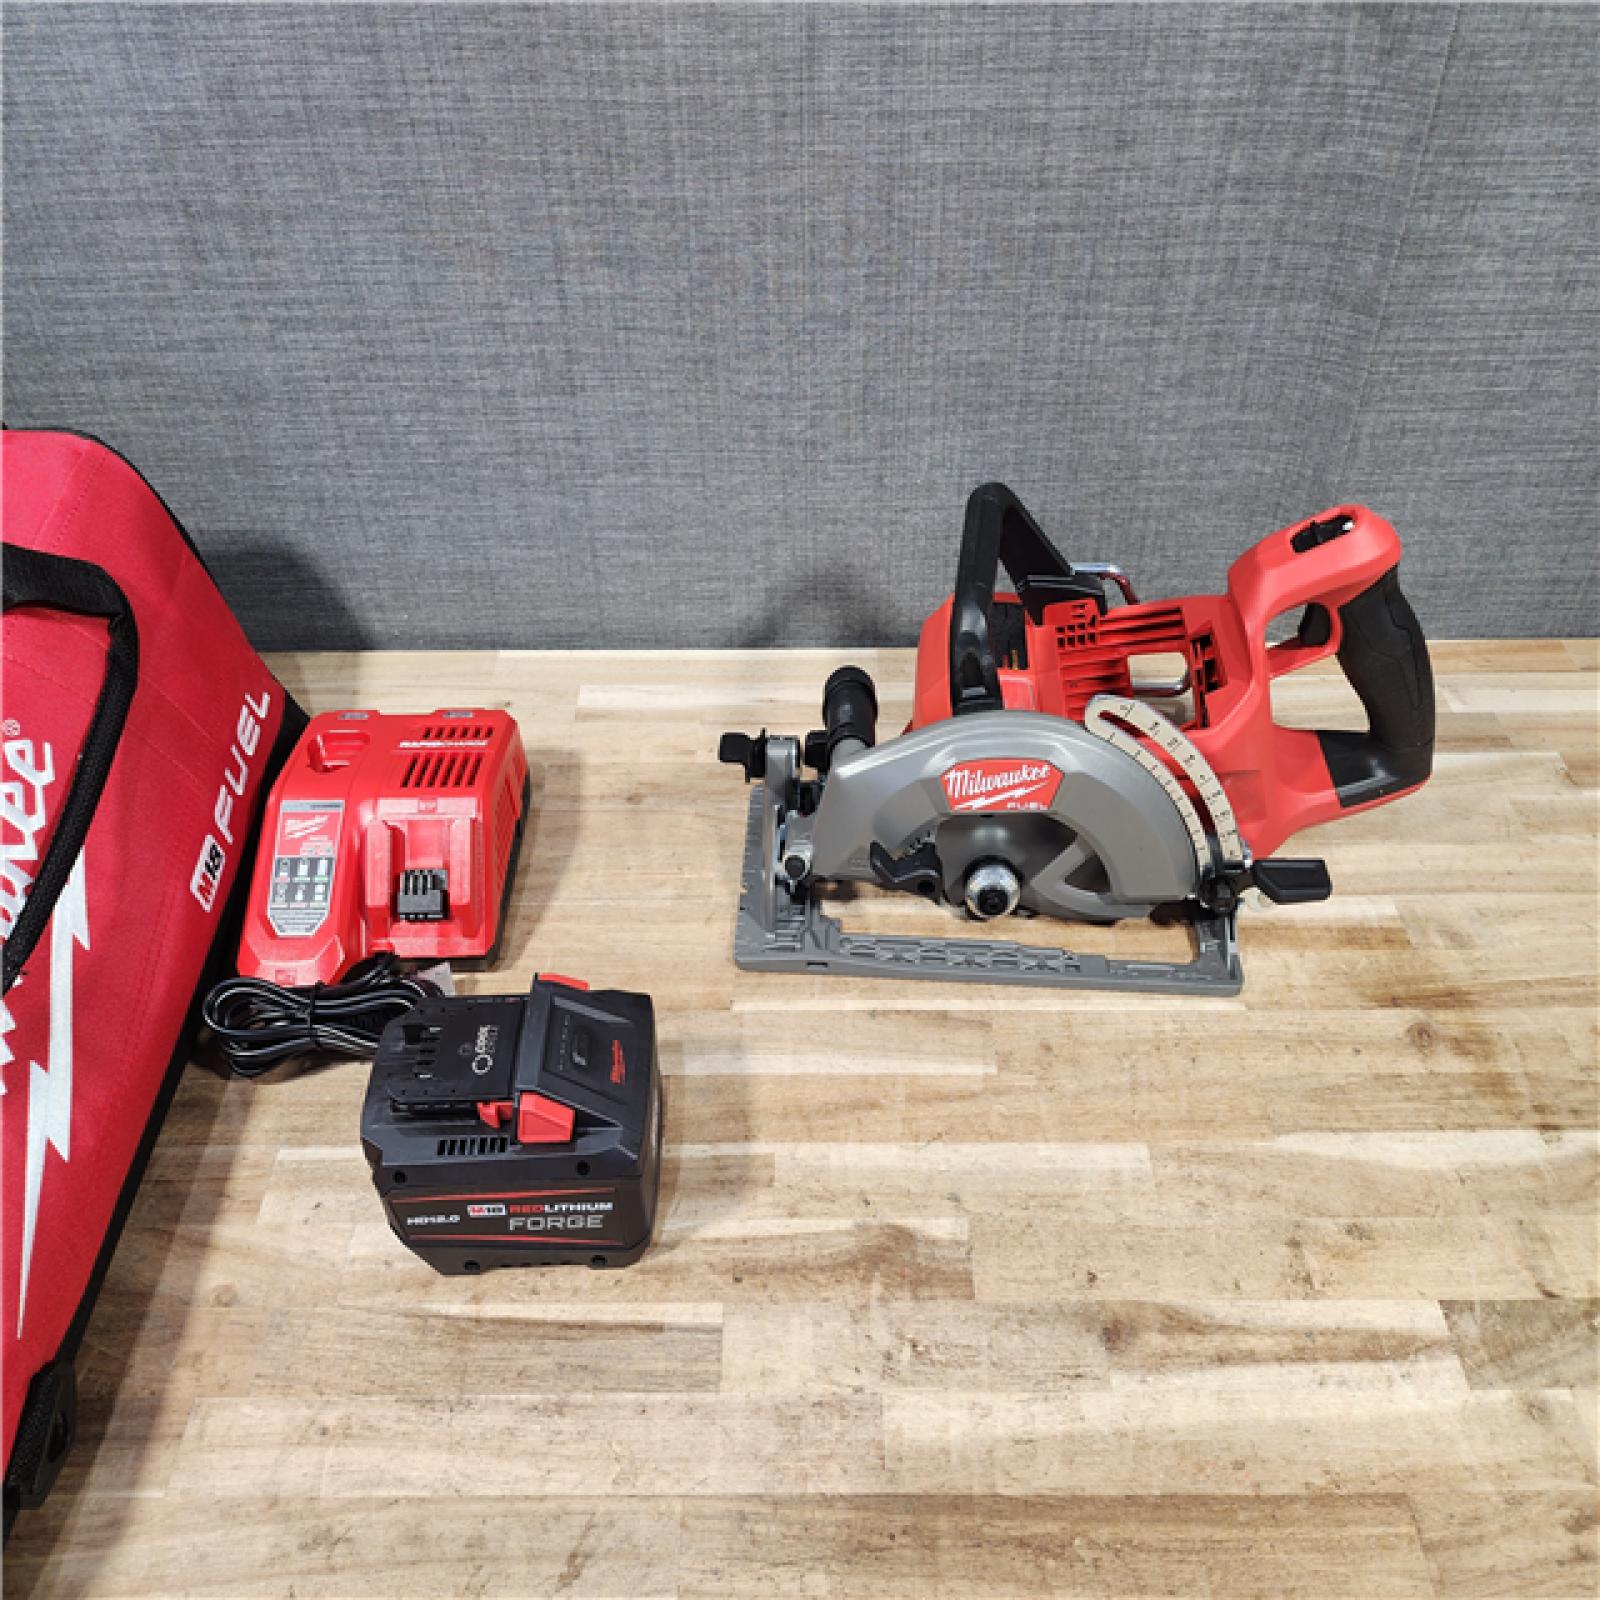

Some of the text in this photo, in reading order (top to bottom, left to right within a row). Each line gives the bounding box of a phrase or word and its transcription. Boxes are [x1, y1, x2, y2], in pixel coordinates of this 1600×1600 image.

[944, 764, 1051, 799] Milwaukee
[195, 692, 270, 909] M18 FUEL
[509, 1201, 614, 1214] REDLITHIUM
[509, 1215, 605, 1231] FORGE
